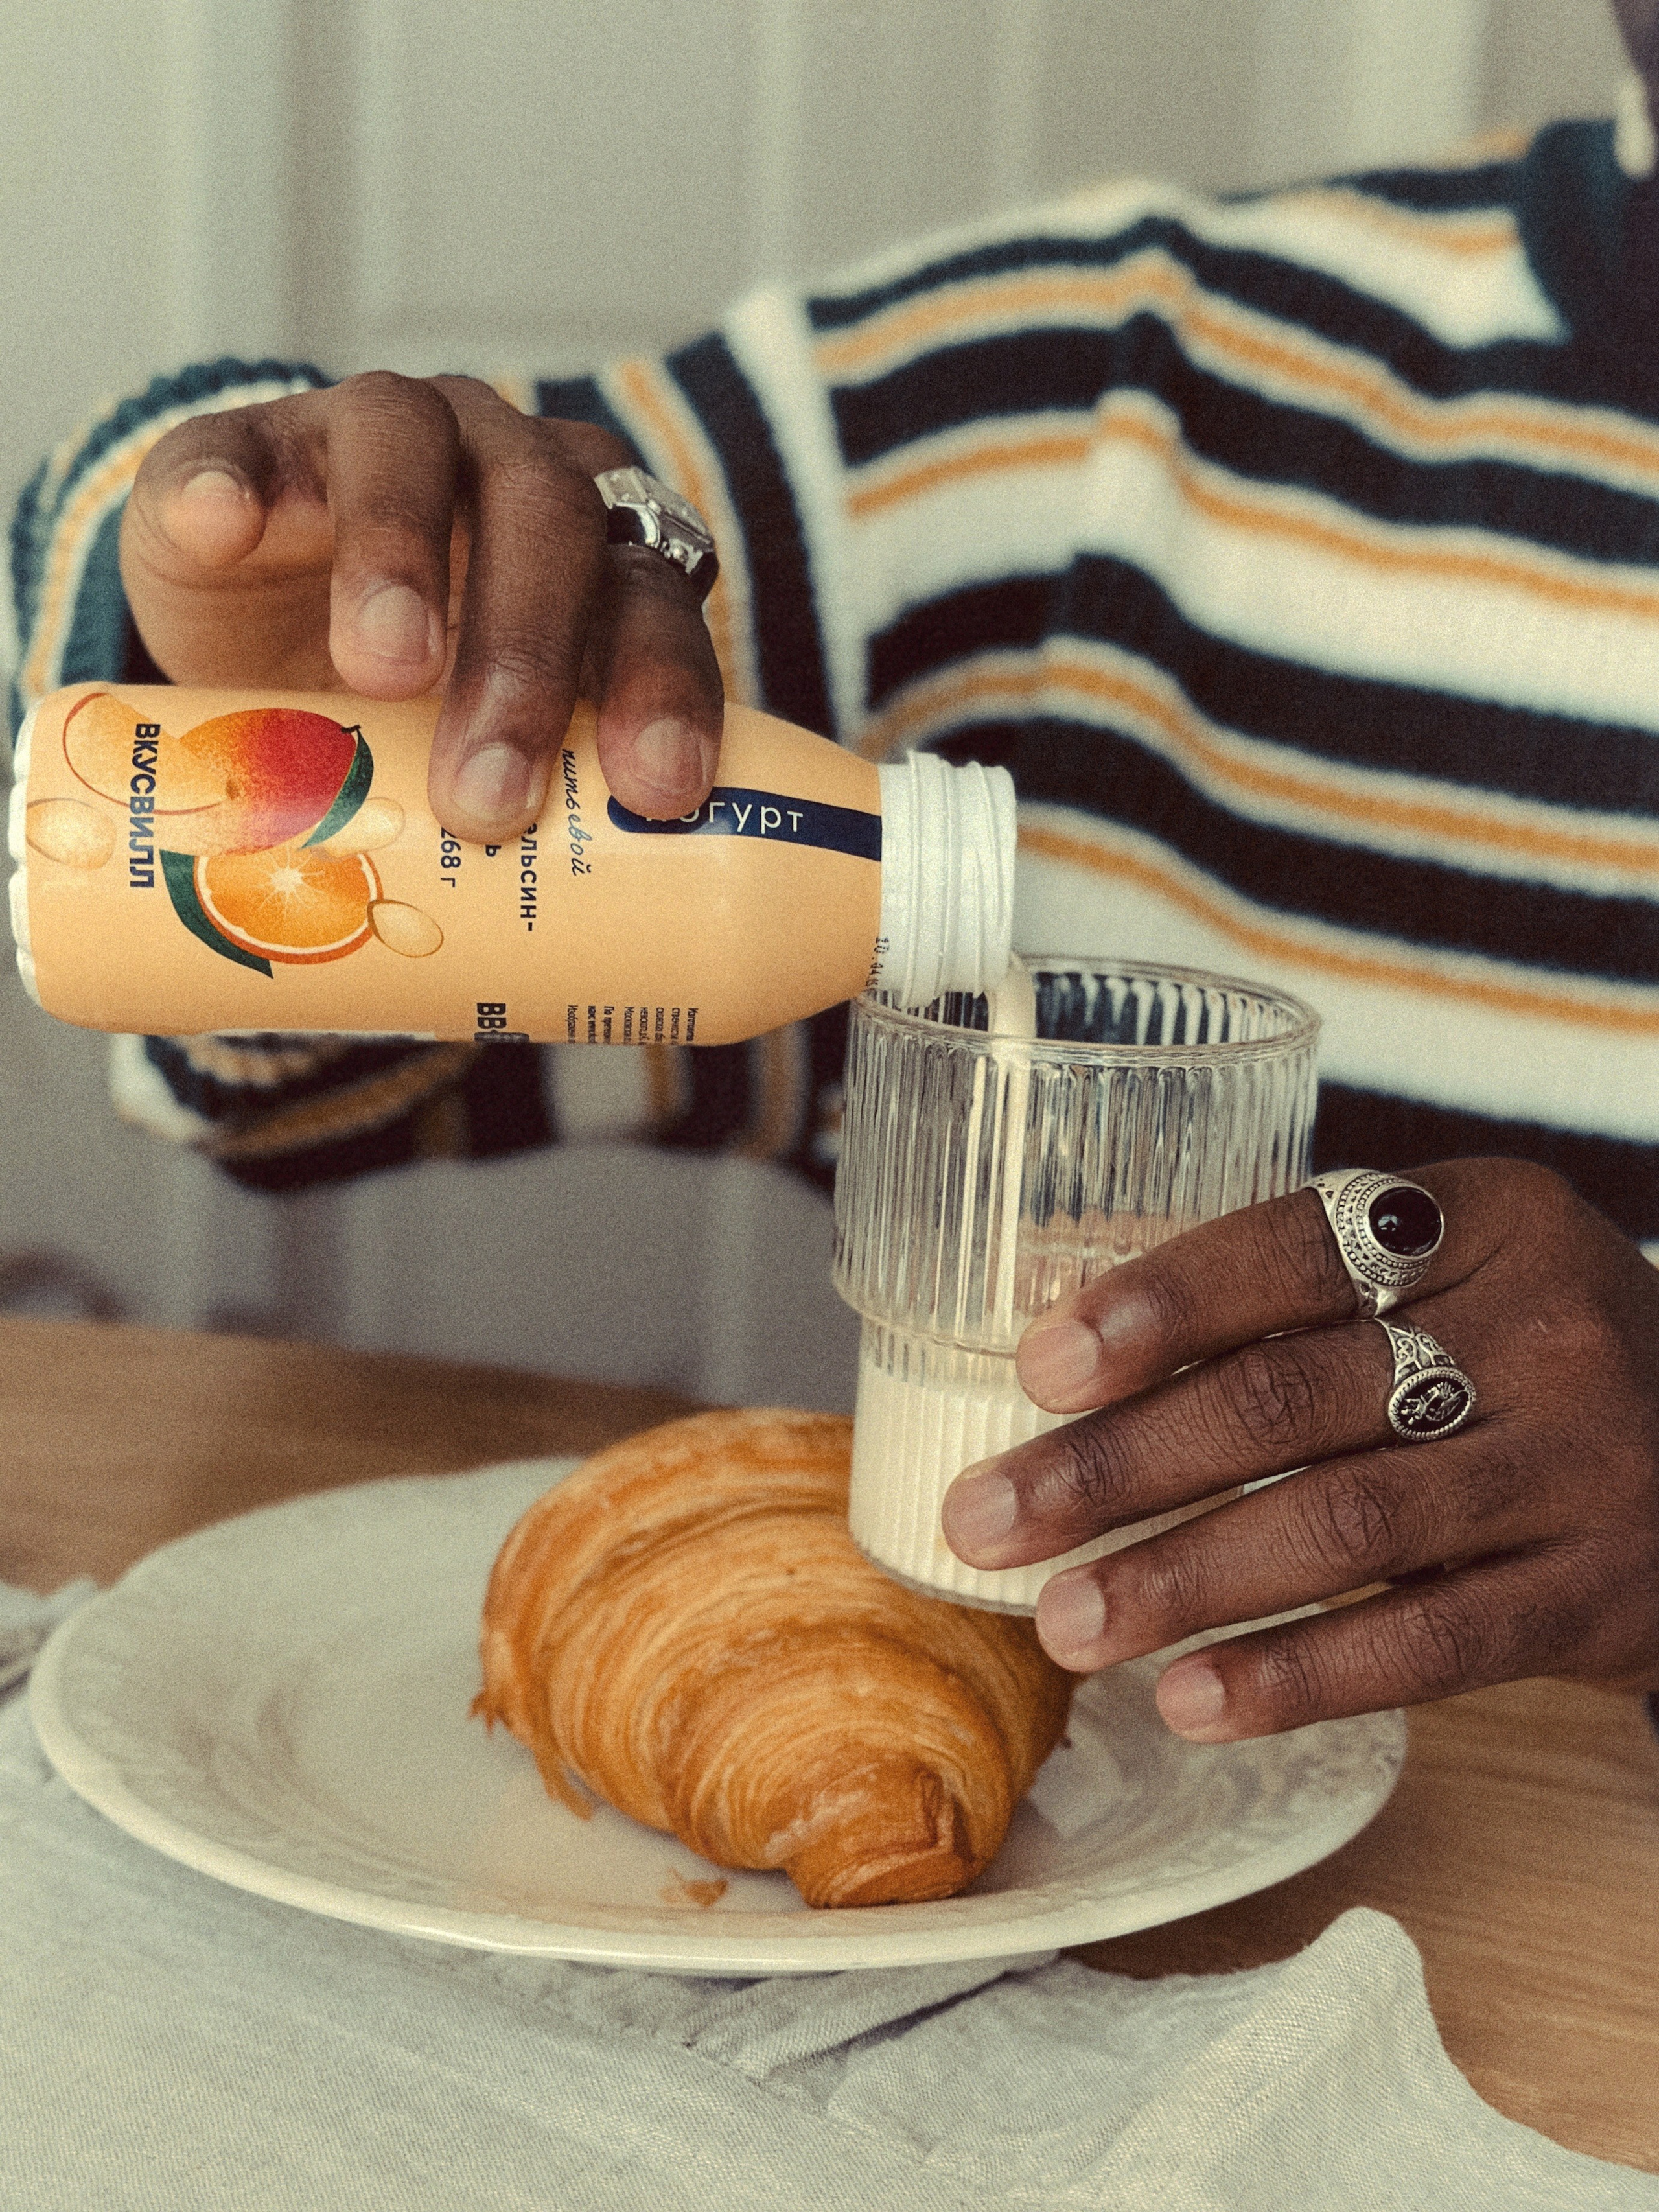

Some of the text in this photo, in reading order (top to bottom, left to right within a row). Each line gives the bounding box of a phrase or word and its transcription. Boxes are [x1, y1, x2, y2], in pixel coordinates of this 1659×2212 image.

[129, 723, 161, 888] ВКУСВИЛЛ
[562, 748, 592, 876] питьевой
[440, 878, 456, 888] г
